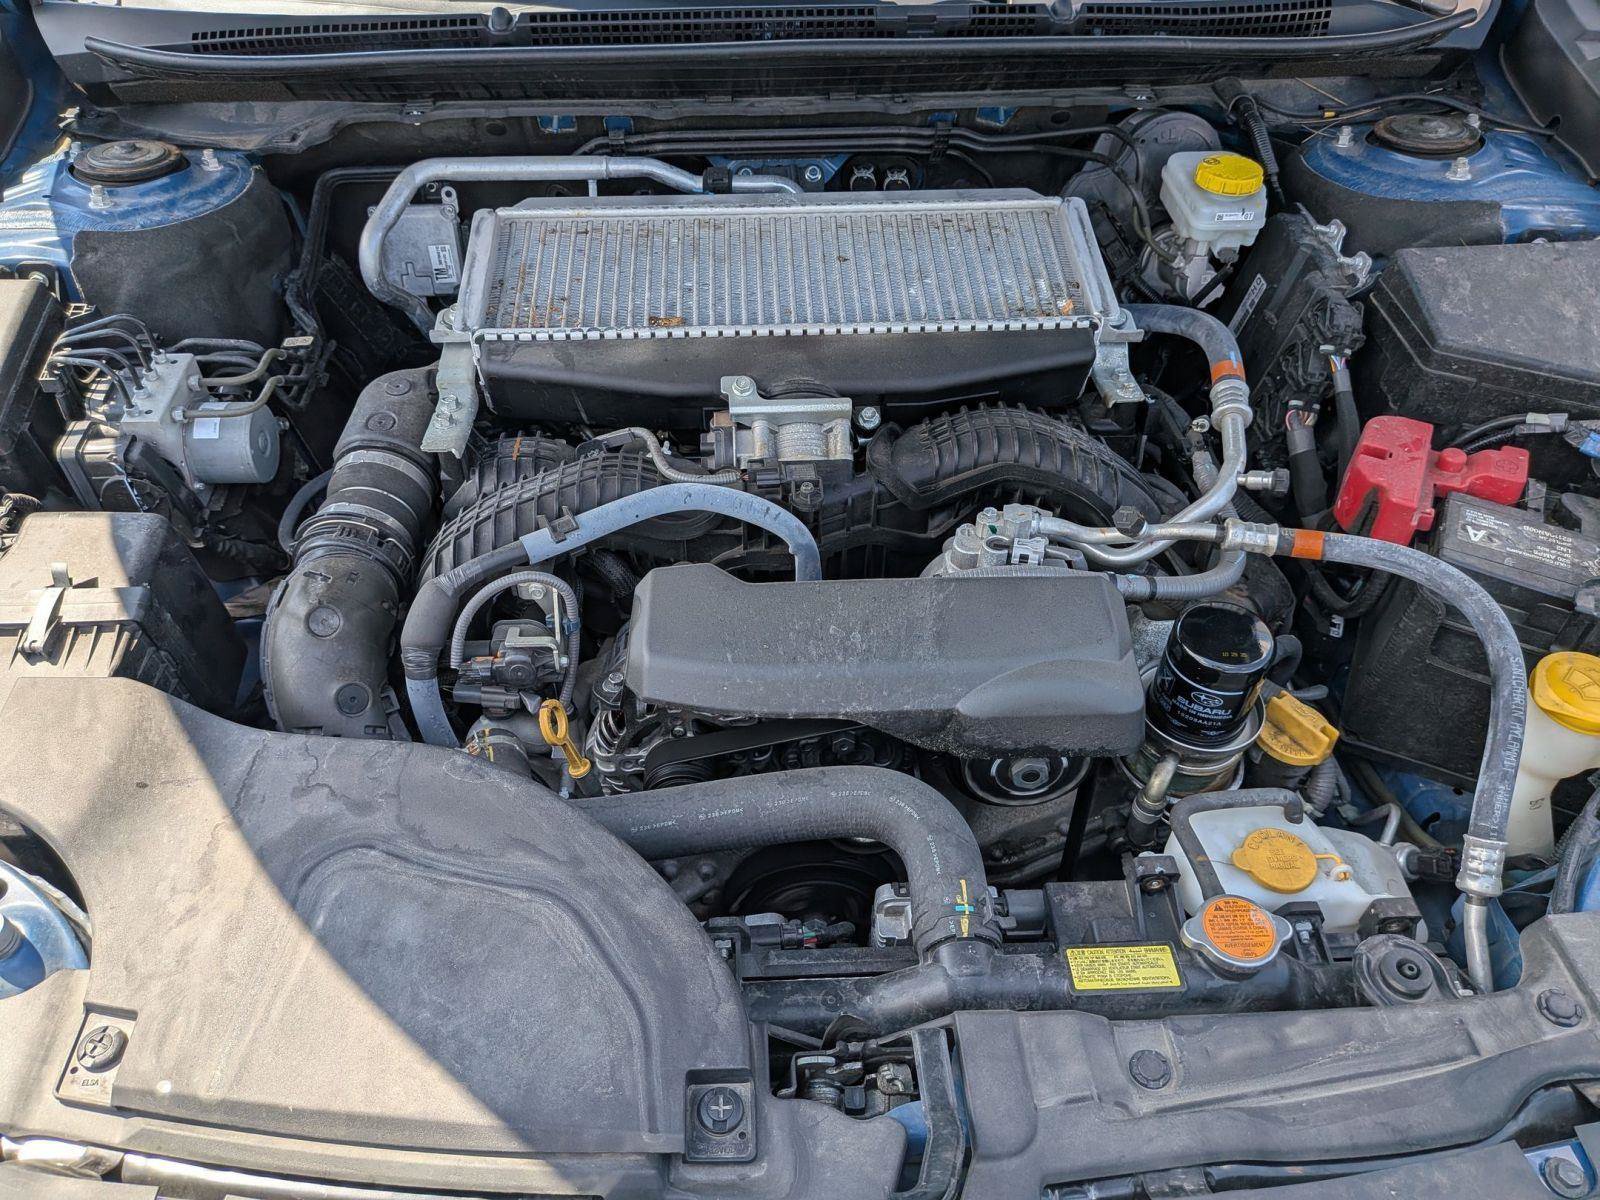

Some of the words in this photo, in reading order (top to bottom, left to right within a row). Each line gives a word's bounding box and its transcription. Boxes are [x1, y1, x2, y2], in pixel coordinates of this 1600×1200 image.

[1533, 550, 1556, 560] AMPS
[1177, 695, 1232, 715] SUBARU
[1247, 829, 1305, 850] COOLANT
